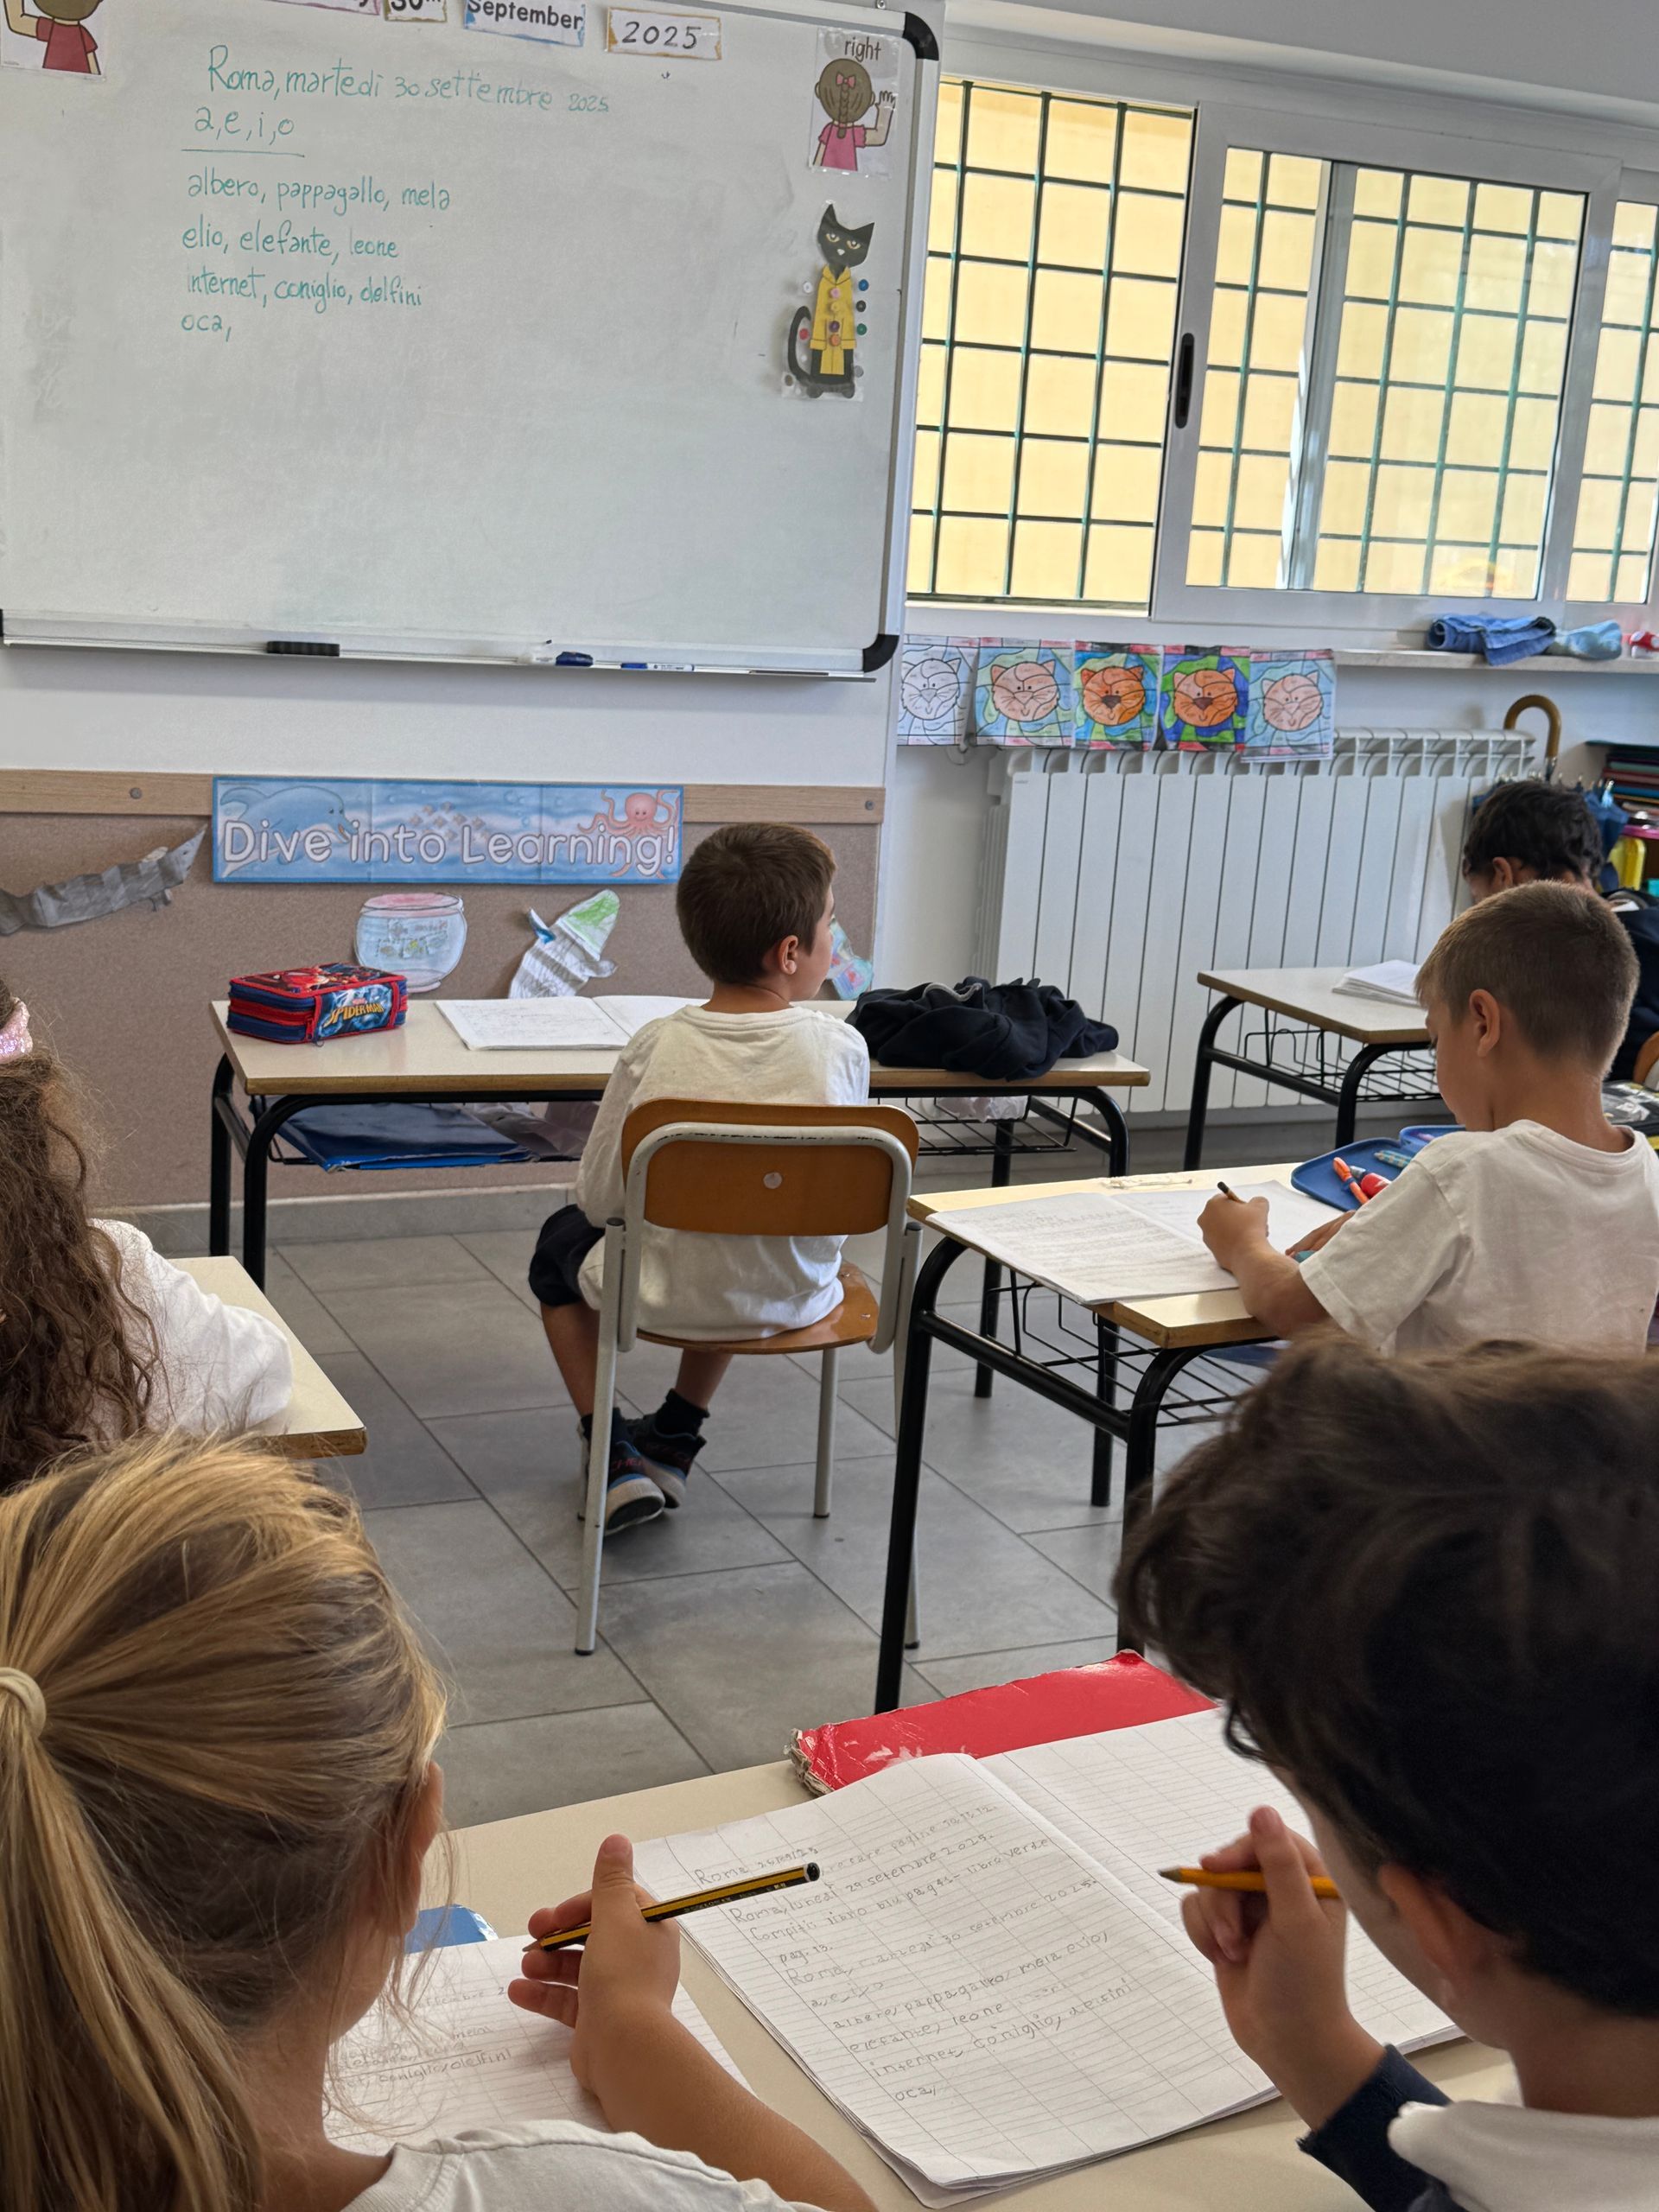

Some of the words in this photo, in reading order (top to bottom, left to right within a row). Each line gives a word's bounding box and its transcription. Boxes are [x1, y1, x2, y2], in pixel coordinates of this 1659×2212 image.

[467, 0, 583, 30] September
[622, 21, 702, 49] 2025
[843, 37, 882, 62] right
[207, 45, 280, 101] Roma,
[395, 76, 421, 99] 30
[567, 92, 610, 113] 2025
[188, 166, 266, 204] albero,
[276, 175, 390, 217] pappagallo,
[402, 180, 451, 211] mela
[181, 213, 229, 255] elio,
[239, 219, 340, 266] elefante,
[349, 226, 400, 258] leone
[187, 263, 267, 308] internet,
[274, 272, 353, 315] coniglio,
[359, 275, 423, 307] delfini
[181, 314, 232, 343] oca,
[223, 818, 333, 863] Dive
[349, 820, 447, 864] into
[461, 823, 675, 876] Learning!
